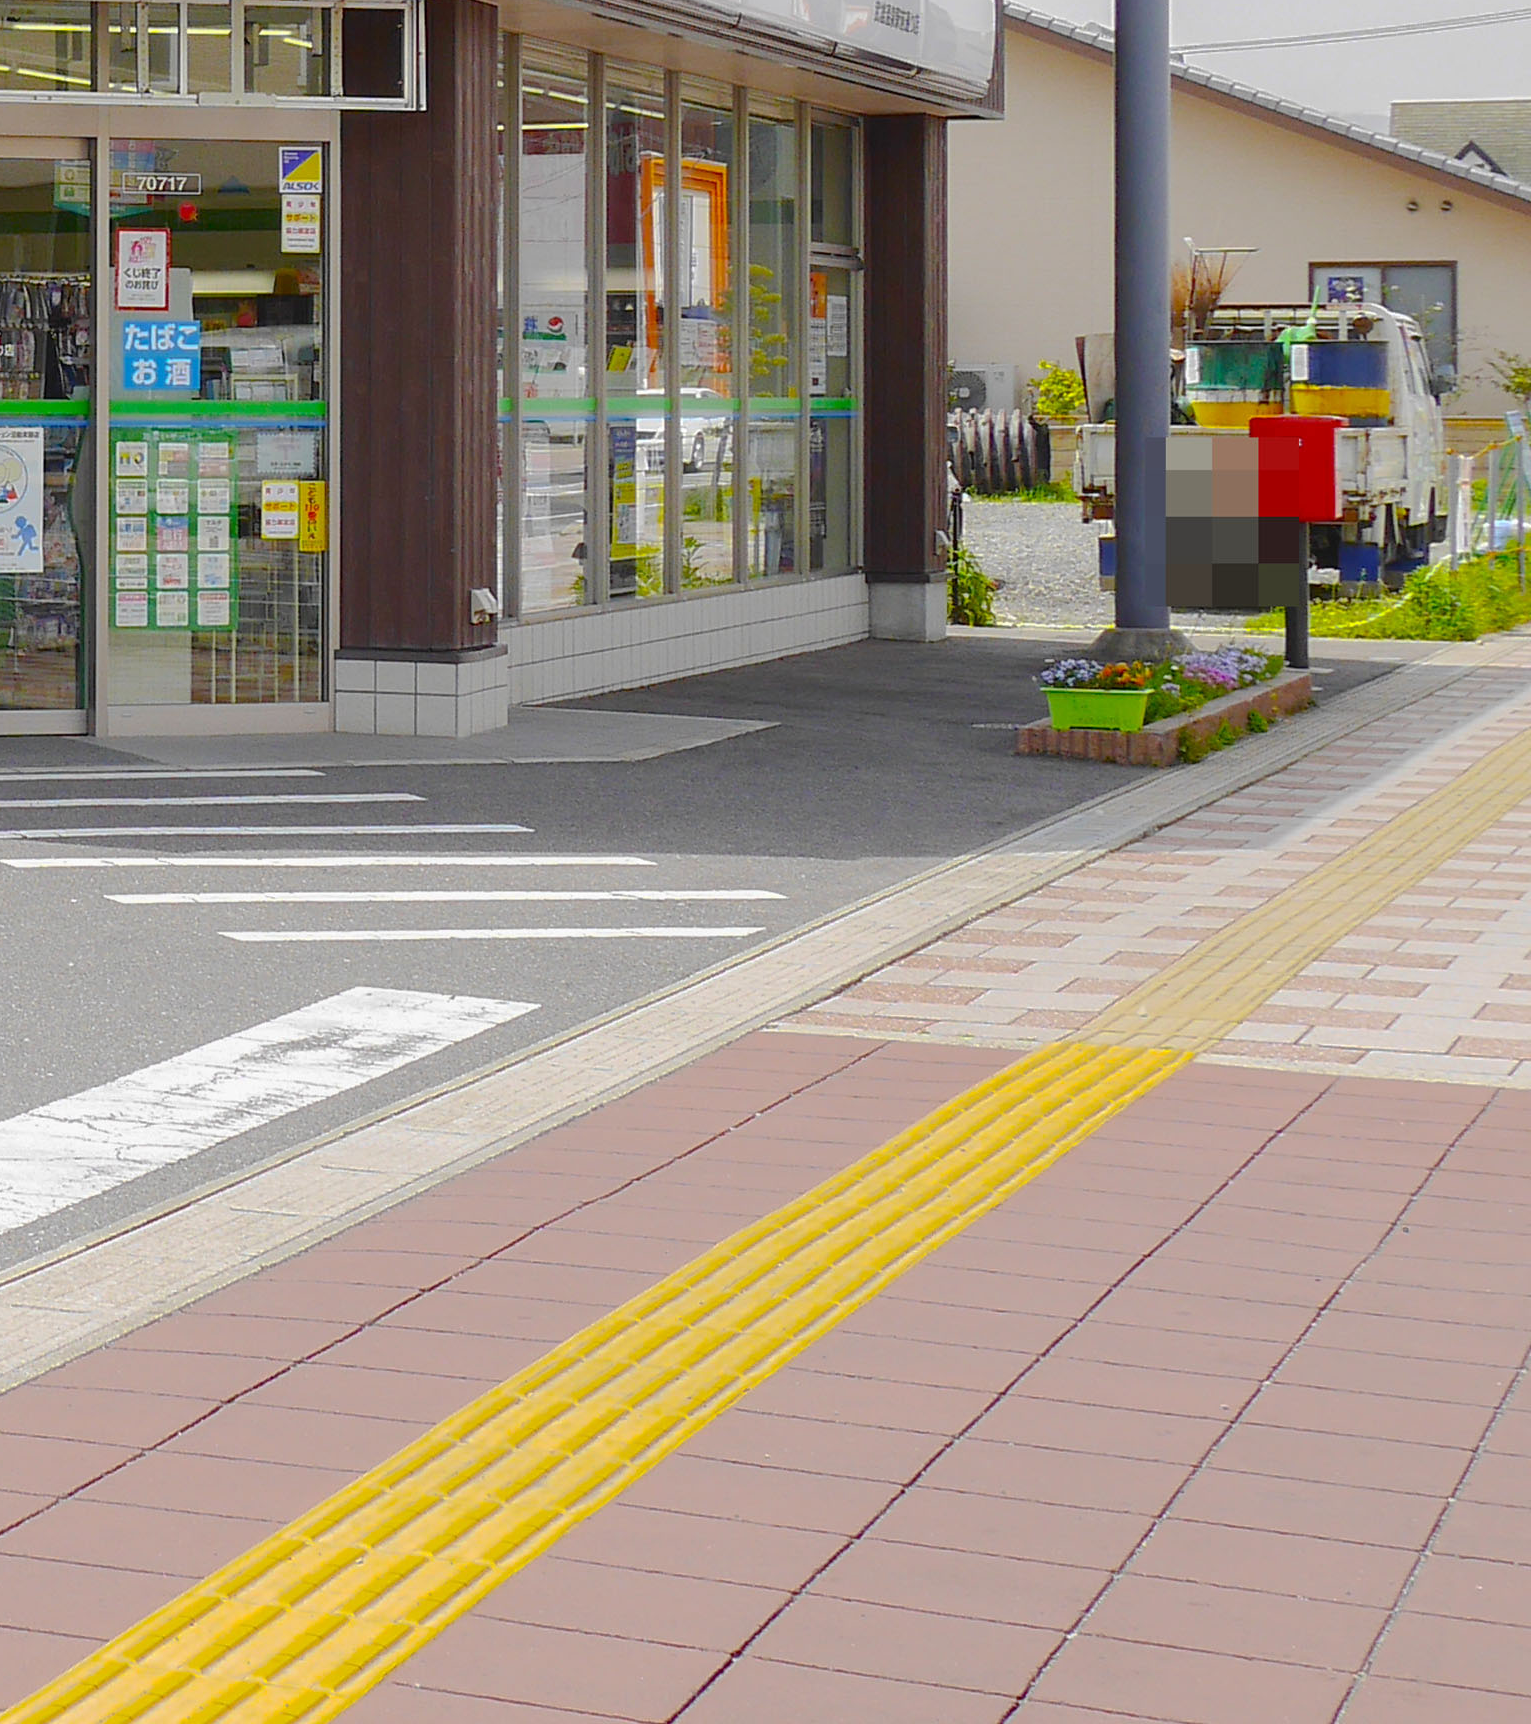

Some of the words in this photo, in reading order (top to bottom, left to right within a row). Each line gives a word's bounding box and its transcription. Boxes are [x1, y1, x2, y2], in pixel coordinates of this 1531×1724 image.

[137, 176, 188, 191] 70717
[282, 182, 319, 190] ALSOK
[124, 268, 161, 279] くじ終了
[125, 323, 199, 350] たばこ
[132, 358, 191, 385] お酒
